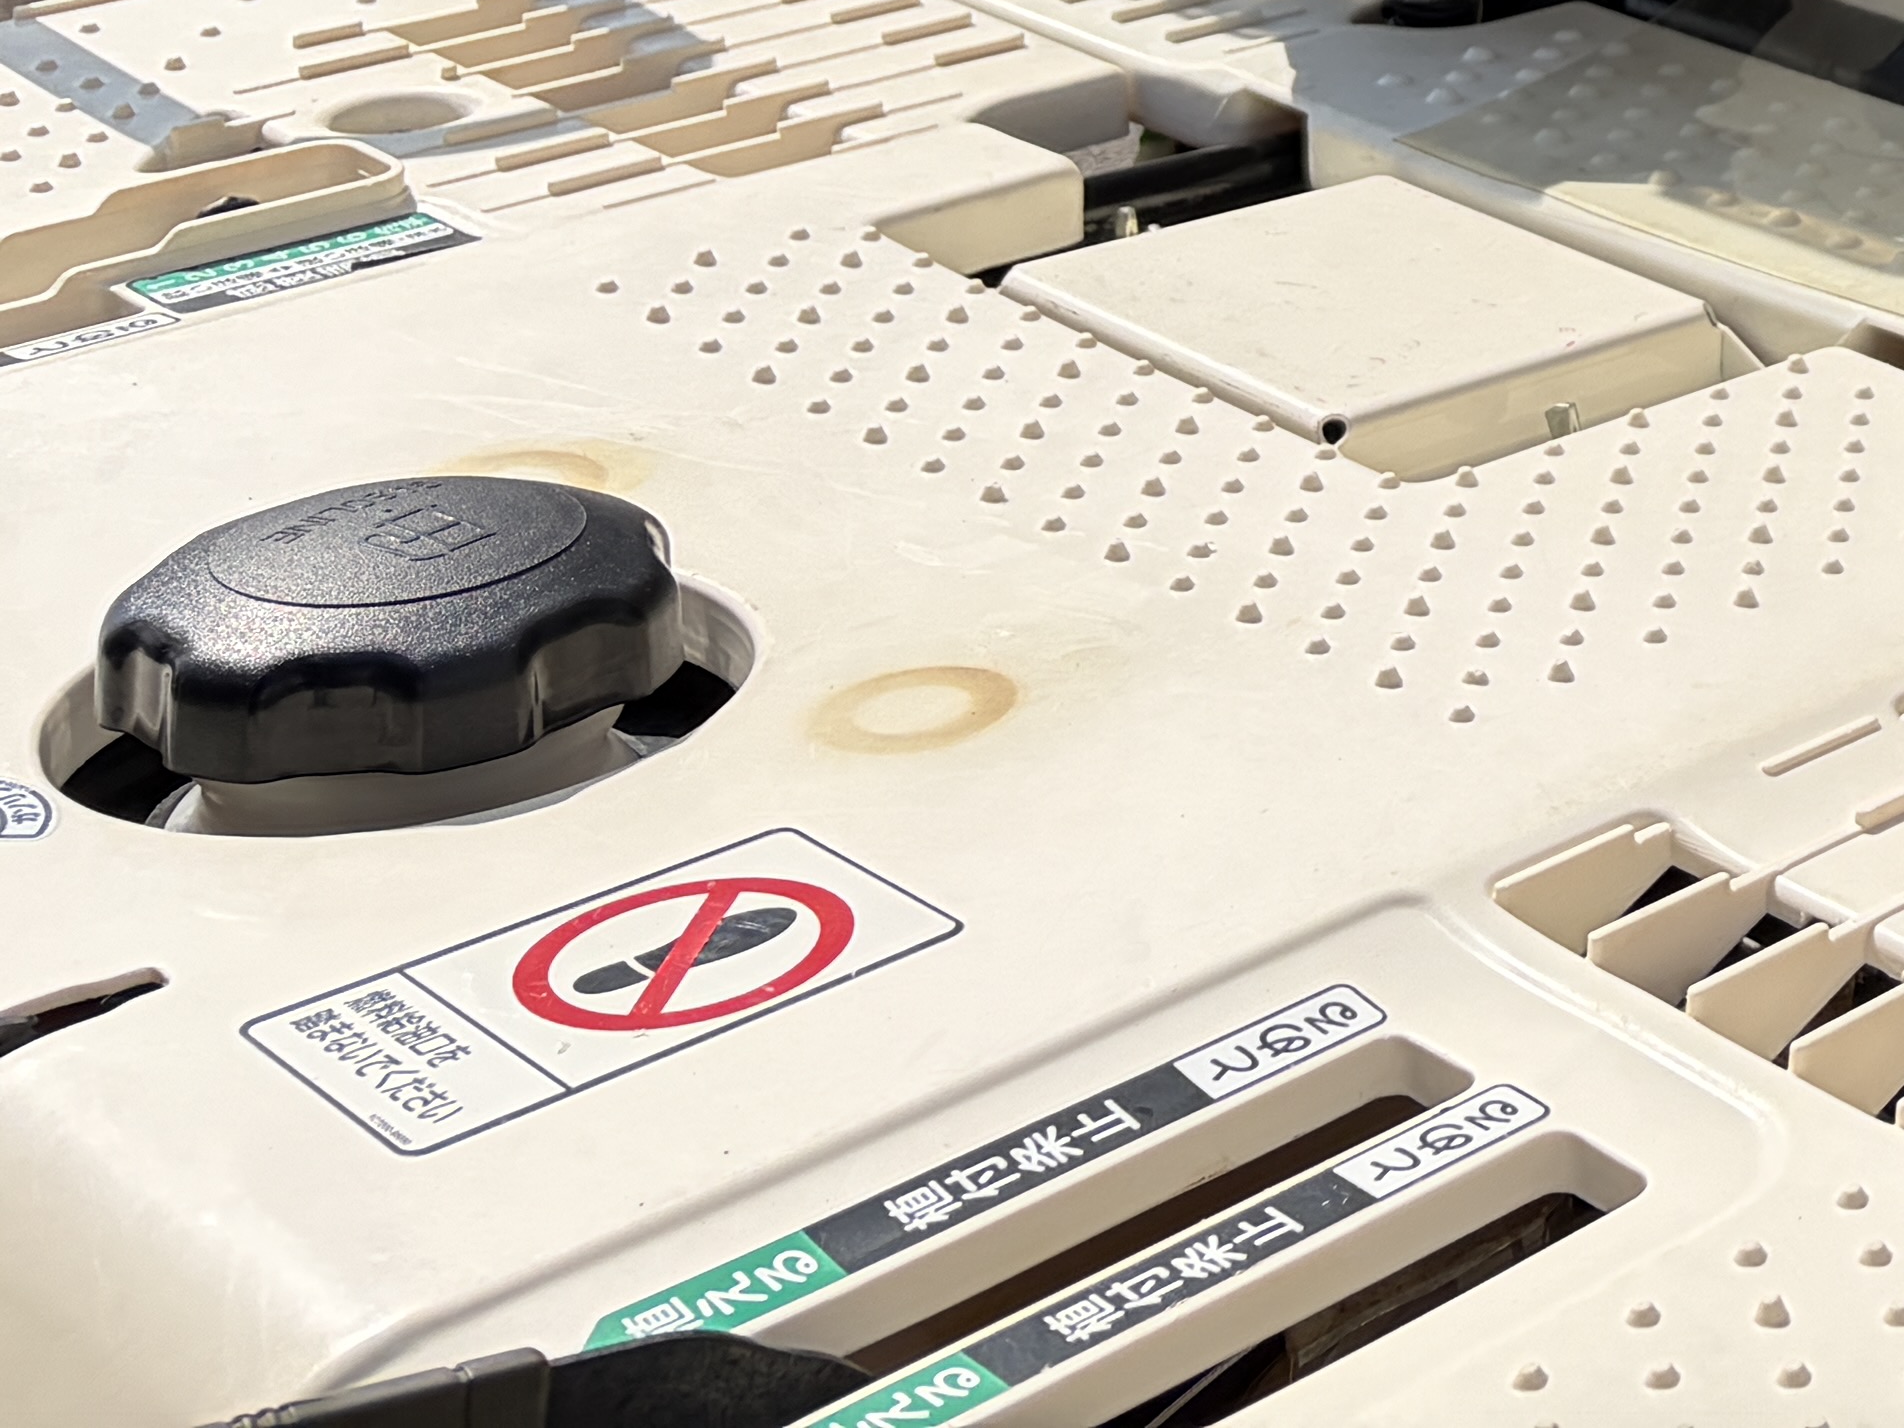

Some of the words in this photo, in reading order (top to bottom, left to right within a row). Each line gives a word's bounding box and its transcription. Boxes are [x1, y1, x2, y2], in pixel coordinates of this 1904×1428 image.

[289, 1008, 464, 1124] 踏まないでください
[1211, 1001, 1358, 1081] とめる
[885, 1099, 1145, 1234] 植付条止
[1370, 1099, 1519, 1182] とめる
[1047, 1204, 1304, 1343] 植付条止
